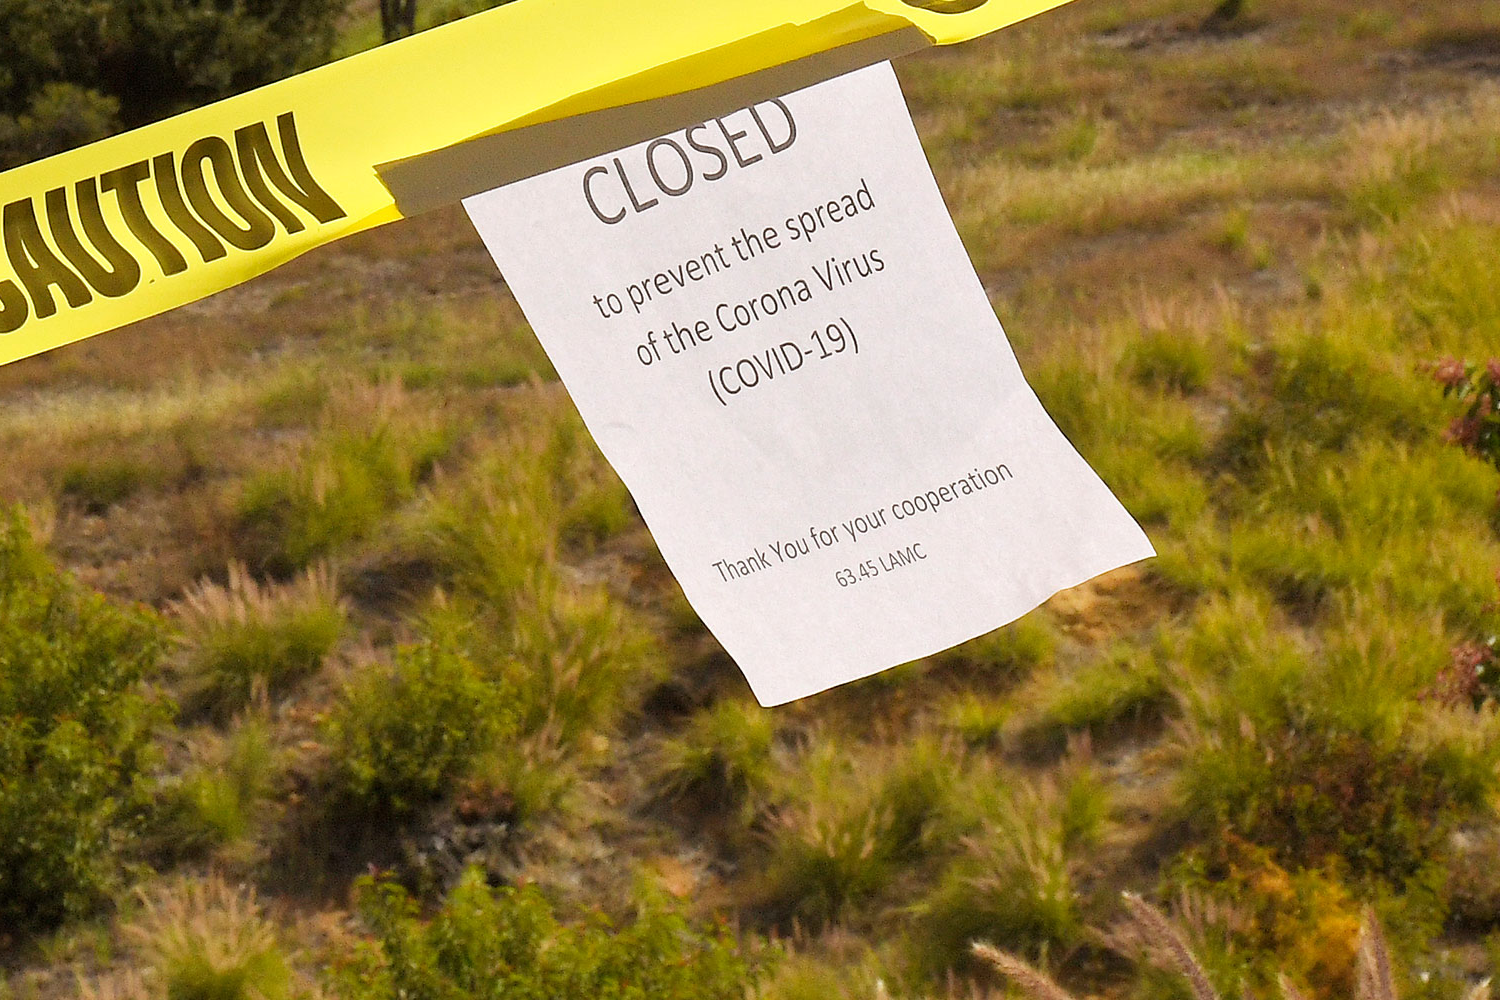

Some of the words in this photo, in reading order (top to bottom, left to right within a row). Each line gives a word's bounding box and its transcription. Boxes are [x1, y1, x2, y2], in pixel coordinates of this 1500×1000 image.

[583, 98, 797, 225] CLOSED
[592, 293, 624, 319] to
[626, 243, 731, 314] prevent
[731, 228, 782, 262] the
[785, 178, 876, 243] spread
[637, 331, 662, 366] of
[663, 322, 713, 354] the
[715, 279, 813, 332] Corona
[812, 249, 886, 292] Virus
[708, 316, 859, 406] (COVID-19)
[712, 548, 772, 583] Thank
[768, 537, 810, 563] You
[810, 526, 840, 549] for
[842, 507, 888, 542] your
[892, 463, 1014, 520] cooperation
[834, 559, 880, 588] 63.45
[882, 543, 928, 573] LAMC
